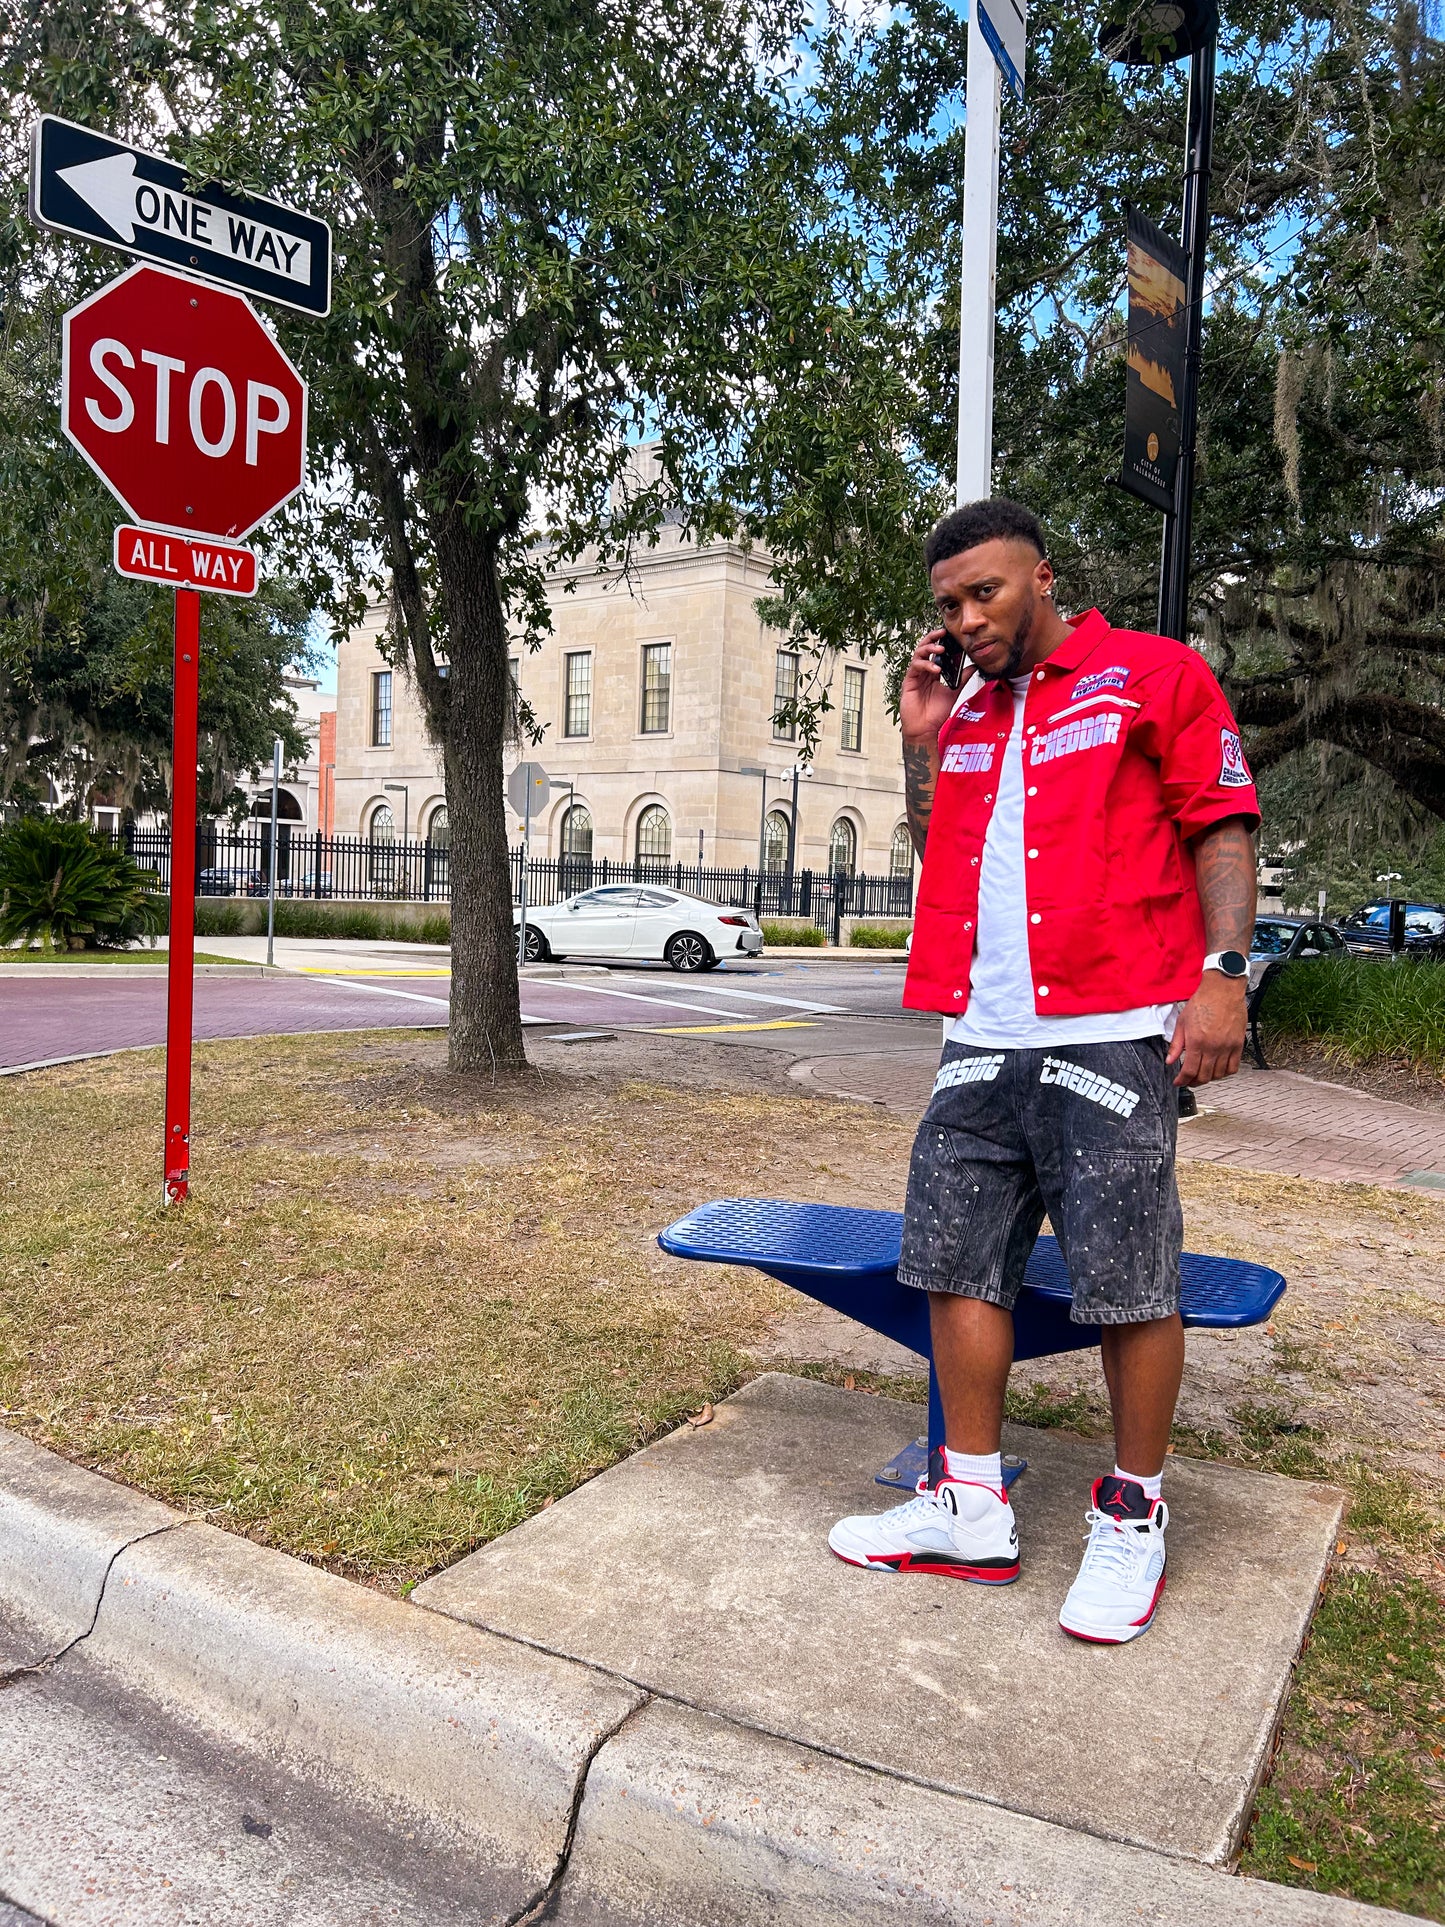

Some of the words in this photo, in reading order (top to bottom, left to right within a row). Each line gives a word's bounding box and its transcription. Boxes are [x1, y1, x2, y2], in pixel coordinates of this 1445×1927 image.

[134, 184, 212, 245] ONE
[227, 216, 301, 273] WAY
[84, 338, 290, 466] STOP
[1141, 459, 1152, 469] CITY
[130, 538, 178, 573] ALL
[192, 551, 244, 583] WAY
